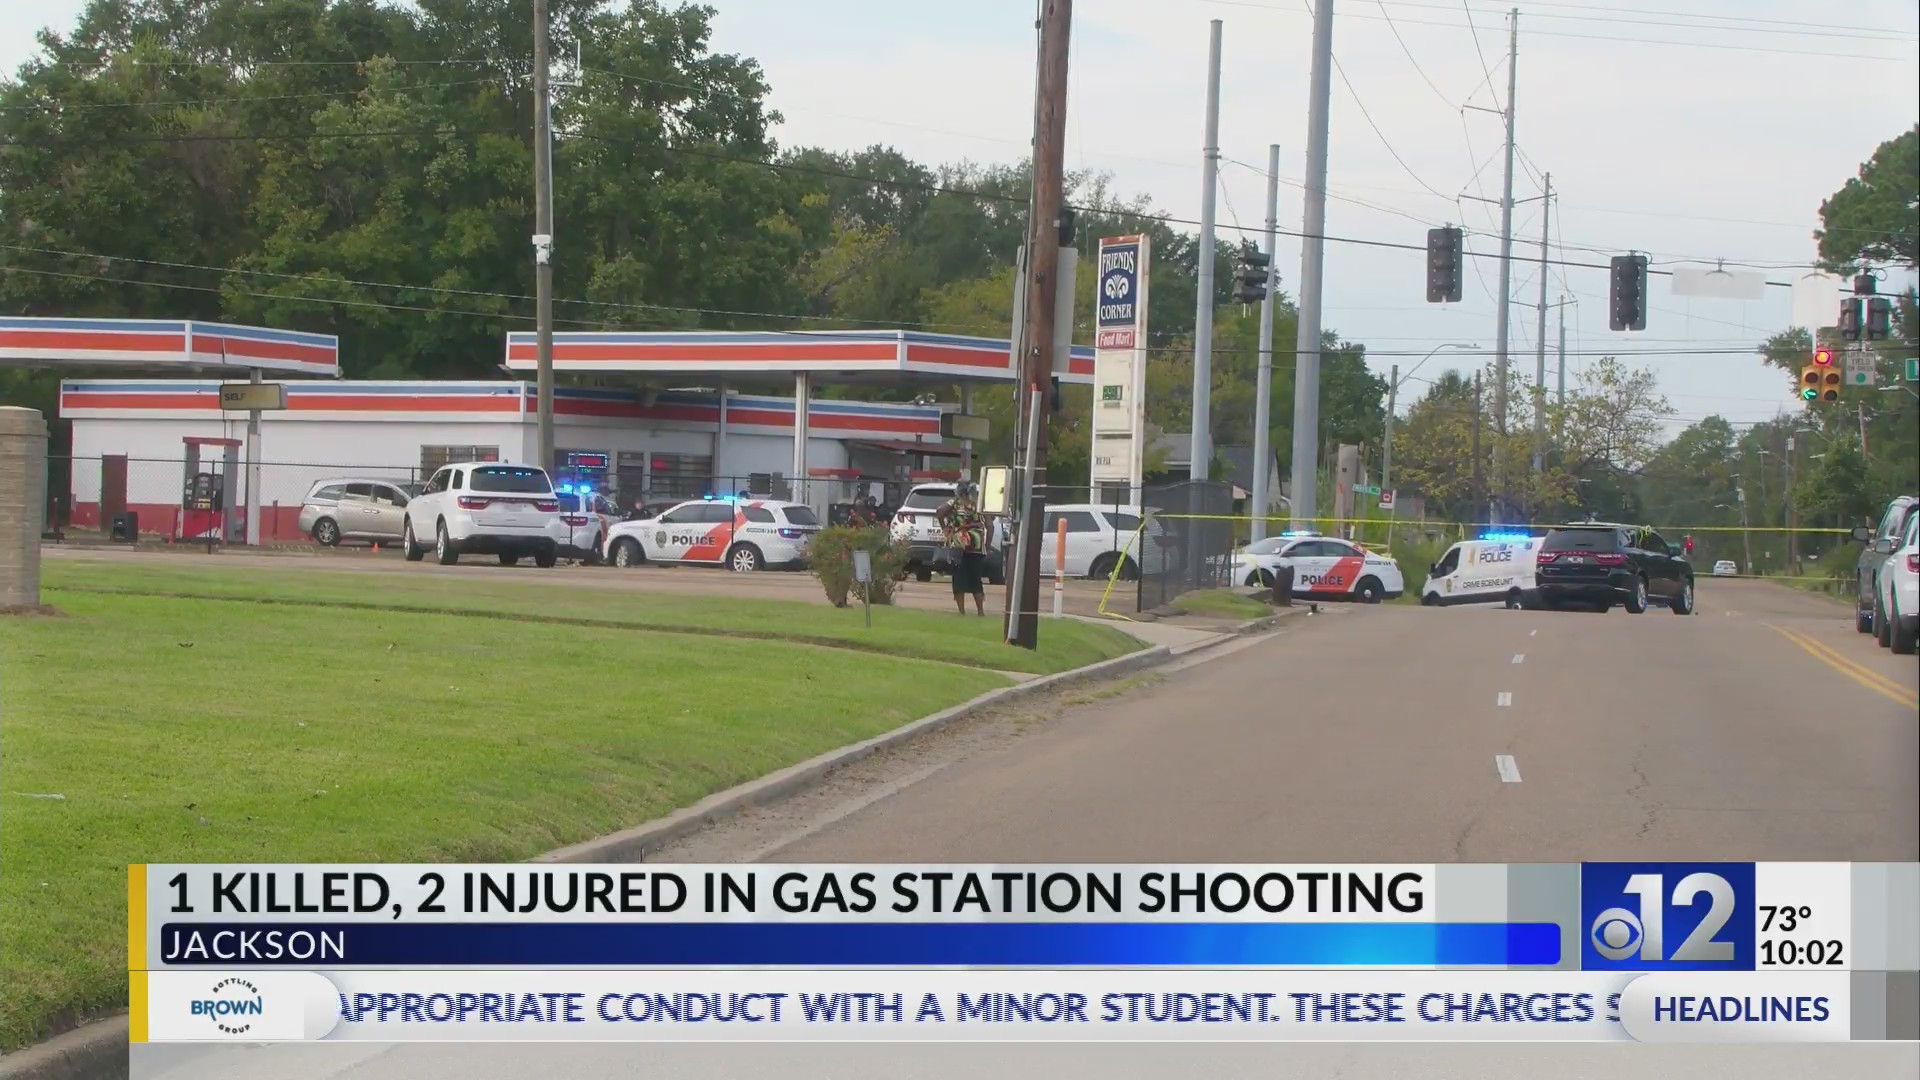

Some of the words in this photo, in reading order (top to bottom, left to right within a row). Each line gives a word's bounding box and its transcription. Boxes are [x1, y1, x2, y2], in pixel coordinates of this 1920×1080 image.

[1102, 251, 1134, 278] FRIENDS
[1100, 303, 1132, 320] CORNER
[1100, 332, 1115, 347] Food
[1116, 332, 1131, 345] Mart
[224, 392, 246, 401] SELF
[671, 535, 715, 546] POLICE
[1479, 551, 1512, 563] POLICE
[1301, 574, 1343, 586] POLICE
[1462, 579, 1481, 589] CRIME
[1481, 578, 1500, 588] SCENE
[1500, 577, 1514, 586] UNIT
